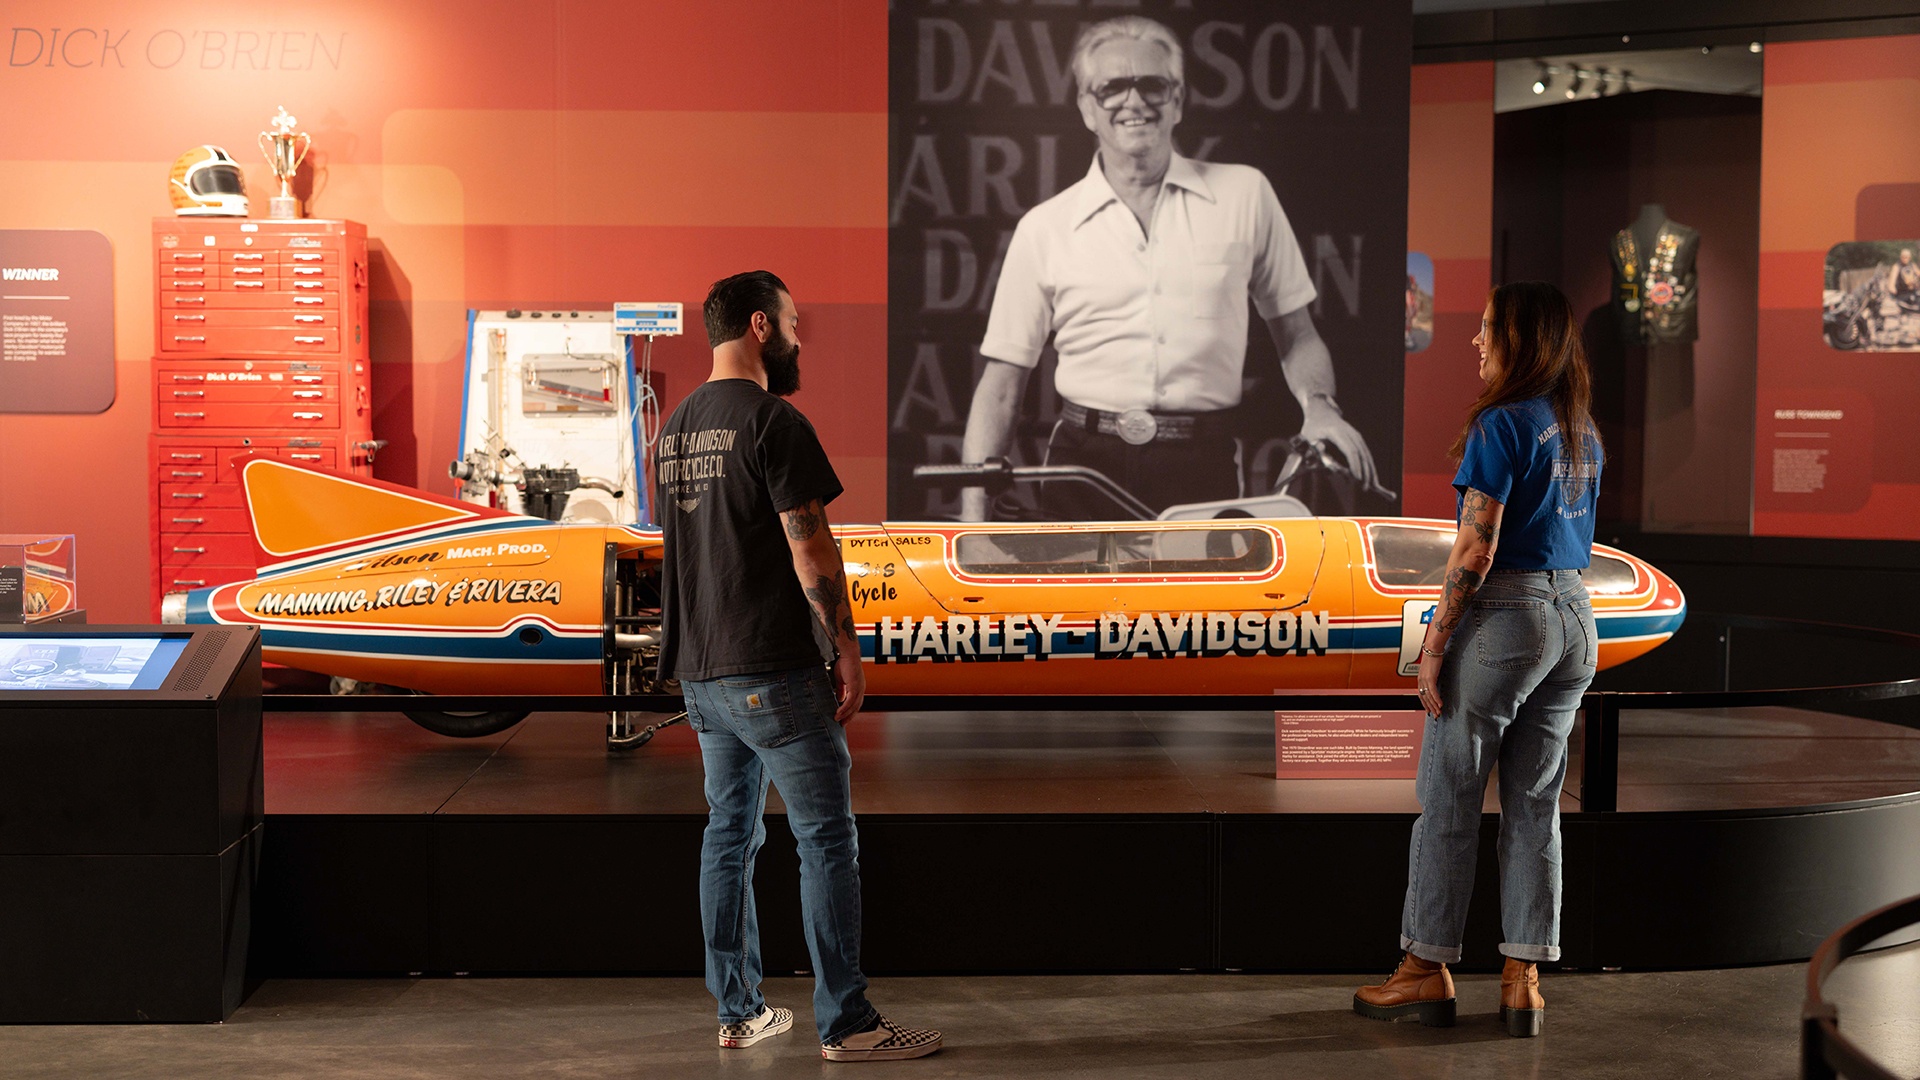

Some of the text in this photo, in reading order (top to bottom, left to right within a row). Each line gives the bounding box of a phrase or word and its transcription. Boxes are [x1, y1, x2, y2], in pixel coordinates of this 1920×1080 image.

[9, 28, 348, 71] DICK O'BRIEN
[917, 17, 1361, 112] DAVSON
[2, 267, 60, 281] WINNER
[206, 372, 227, 382] Dick
[228, 372, 262, 382] O'Brien
[446, 547, 495, 560] MACH.
[497, 543, 548, 556] PROD.
[850, 536, 932, 548] DYTCH SALES
[375, 579, 450, 610] RILEY
[465, 579, 562, 605] RIVERA
[851, 580, 898, 609] Cycle
